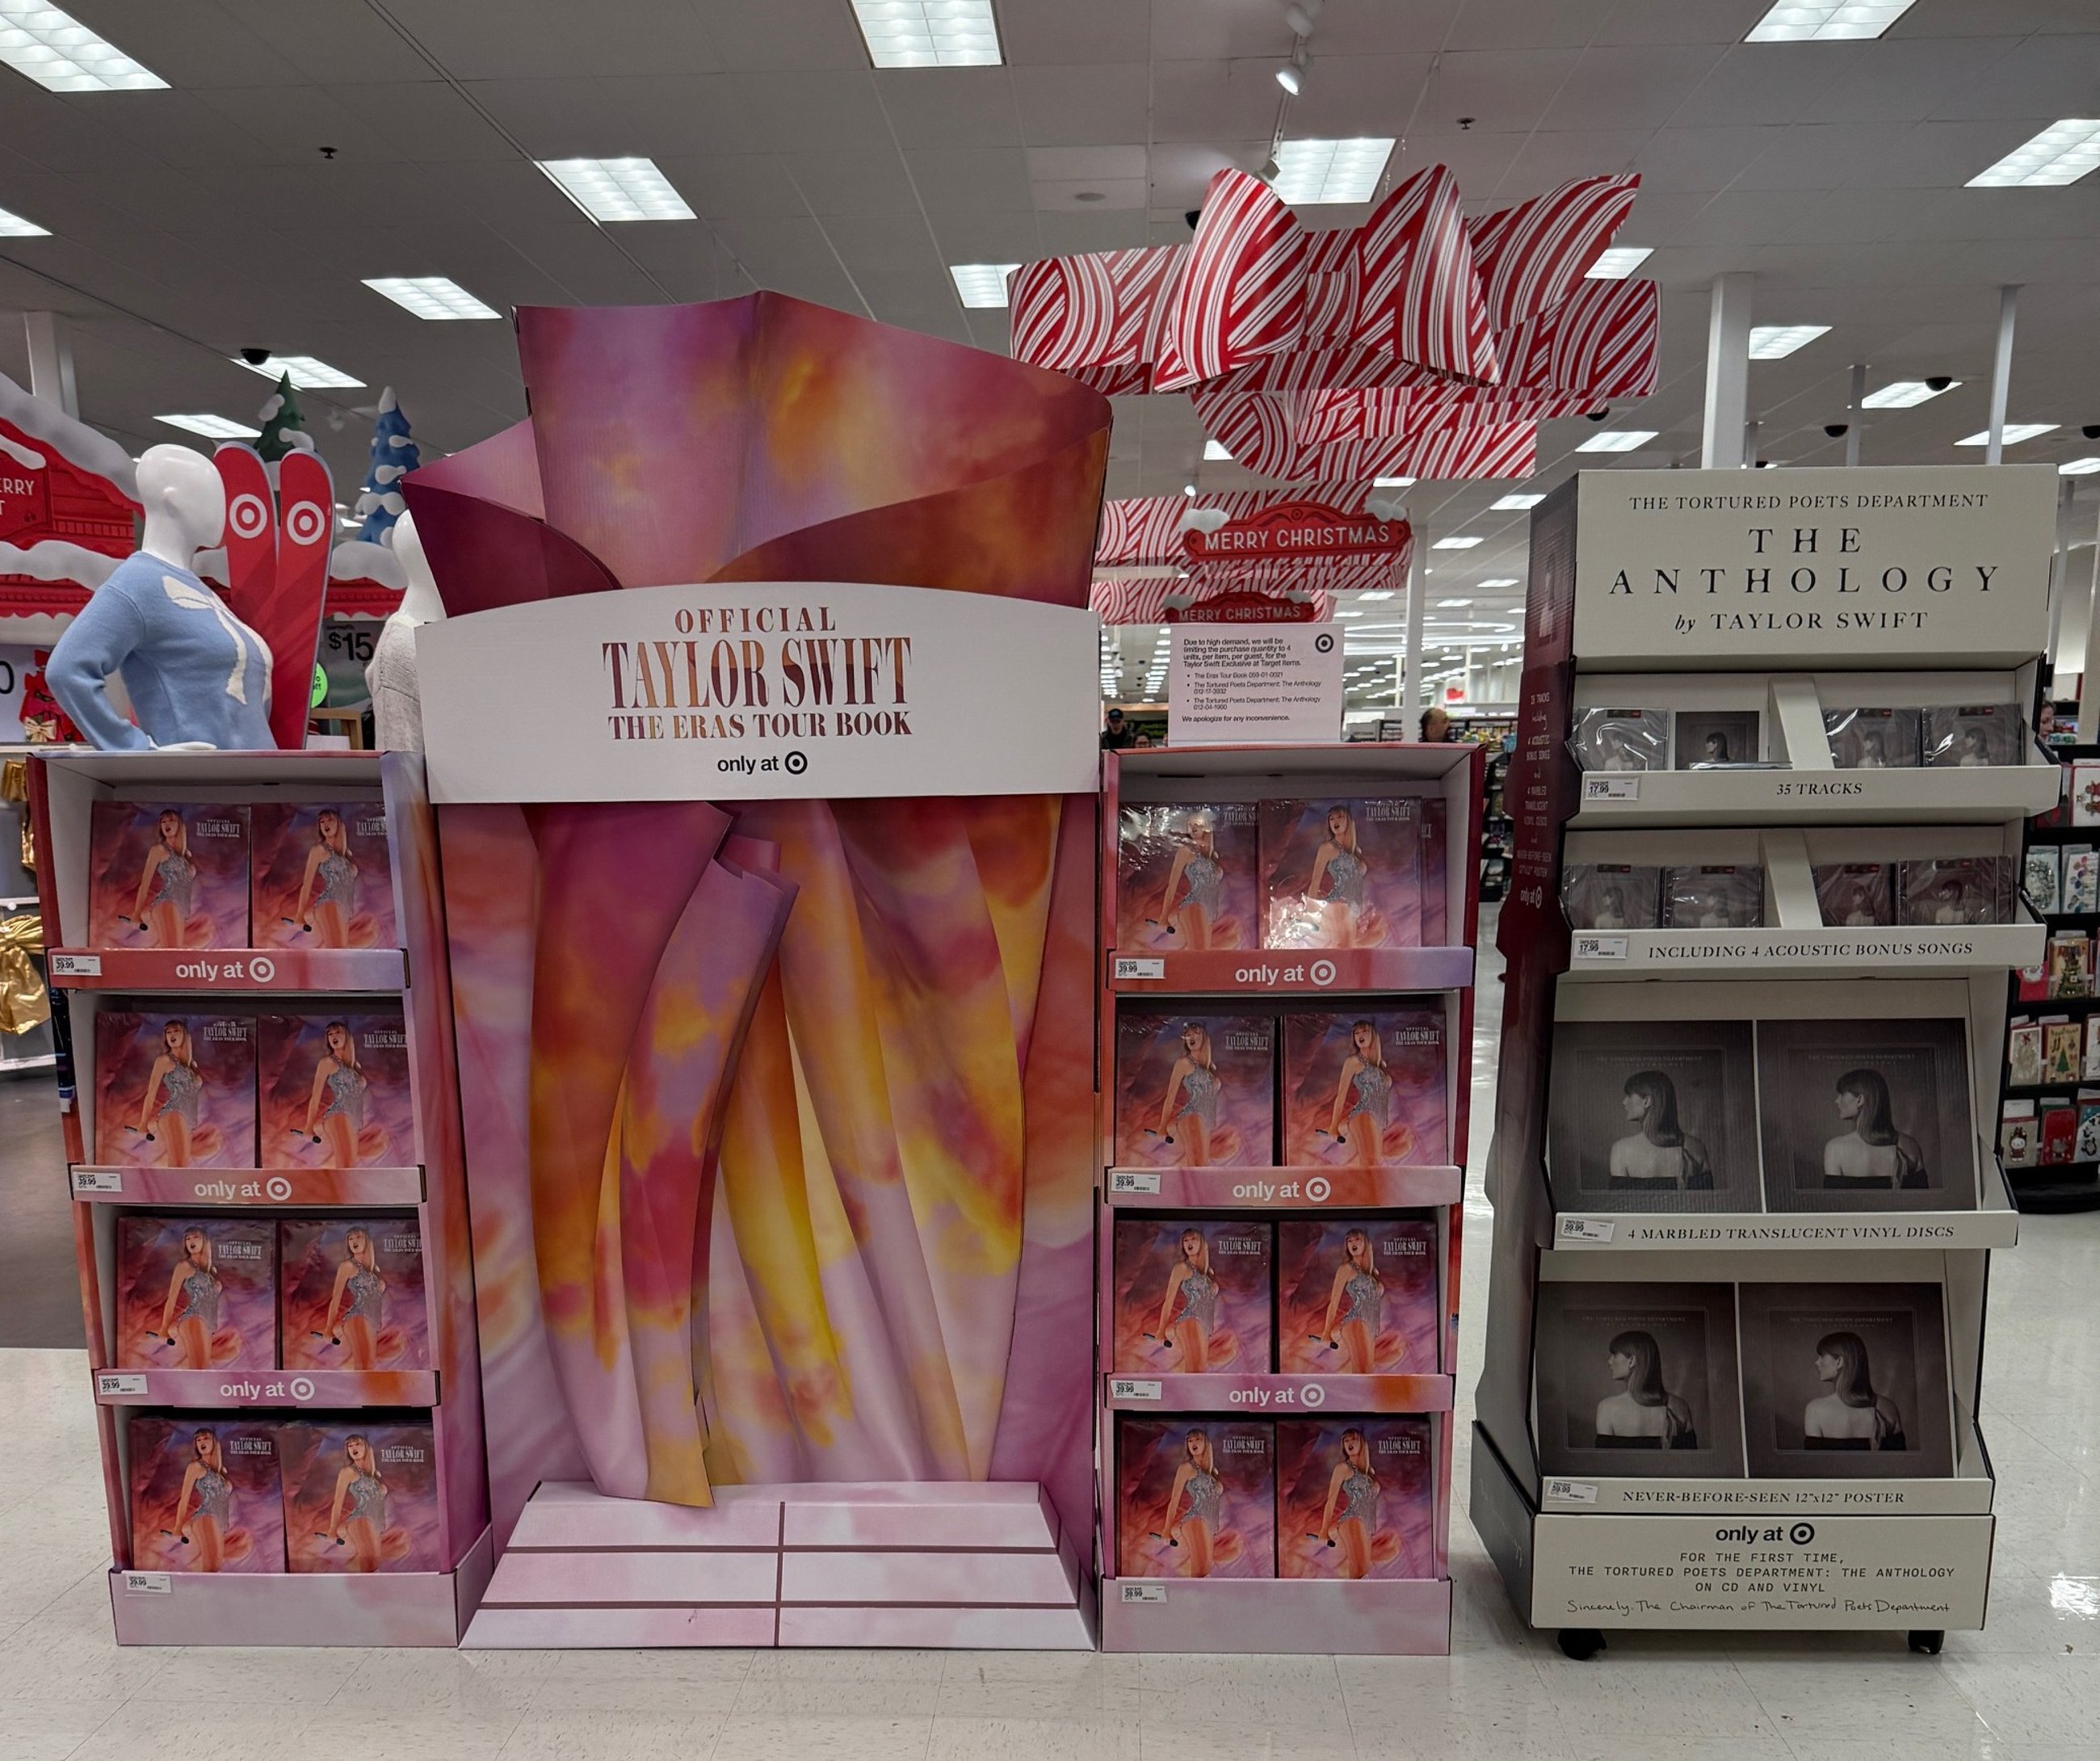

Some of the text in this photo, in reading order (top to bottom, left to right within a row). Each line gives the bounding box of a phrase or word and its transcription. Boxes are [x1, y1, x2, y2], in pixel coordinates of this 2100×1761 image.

[0, 477, 34, 496] RRY
[1629, 494, 1989, 510] THE TORTURED POETS DEPARTMENT
[1204, 526, 1389, 551] MERRY CHRISTMAS
[1749, 527, 1861, 553] THE
[1609, 566, 1998, 594] ANTHOLOGY
[674, 607, 836, 633] OFFICIAL
[1178, 606, 1300, 622] MERRY CHRISTMAS
[1675, 612, 1929, 634] by TAYLOR SWIFT
[602, 637, 912, 708] TAYLOR SWIFT
[608, 711, 913, 739] THE ERAS TOUR BOOK
[717, 755, 779, 775] only at
[1590, 785, 1609, 794] 17.99
[1777, 783, 1863, 795] 35 TRACKS
[1579, 944, 1598, 952] 17.99
[1648, 942, 1973, 959] INCLUDING 4 ACOUSTIC BONUS SONGS
[176, 960, 243, 980] only at
[1118, 965, 1137, 973] 39.99
[1235, 964, 1304, 986] only at
[194, 1179, 261, 1200] only at
[1115, 1179, 1134, 1187] 39.99
[1232, 1180, 1300, 1201] only at
[1628, 1226, 1955, 1239] 4 MARBLED TRANSLUCENT VINYL DISCS
[220, 1379, 284, 1400] only at
[1229, 1386, 1295, 1408] only at
[1623, 1491, 1791, 1503] NEVER-BEFORE-SEEN
[1844, 1492, 1905, 1503] POSTER
[1716, 1527, 1784, 1545] only at
[1680, 1553, 1845, 1565] FOR THE FIRST TIME,
[1569, 1566, 1955, 1578] THE TORTURED POETS DEPARTMENT: THE ANTHOLOGY
[1695, 1582, 1826, 1593] ON CD AND VINYL
[1636, 1600, 1661, 1612] The
[1670, 1600, 1734, 1612] Chairman
[1741, 1601, 1756, 1611] of
[1761, 1601, 1785, 1610] The
[1786, 1598, 1837, 1610] Tortured
[1844, 1599, 1872, 1612] Poets
[1875, 1599, 1951, 1614] Department
